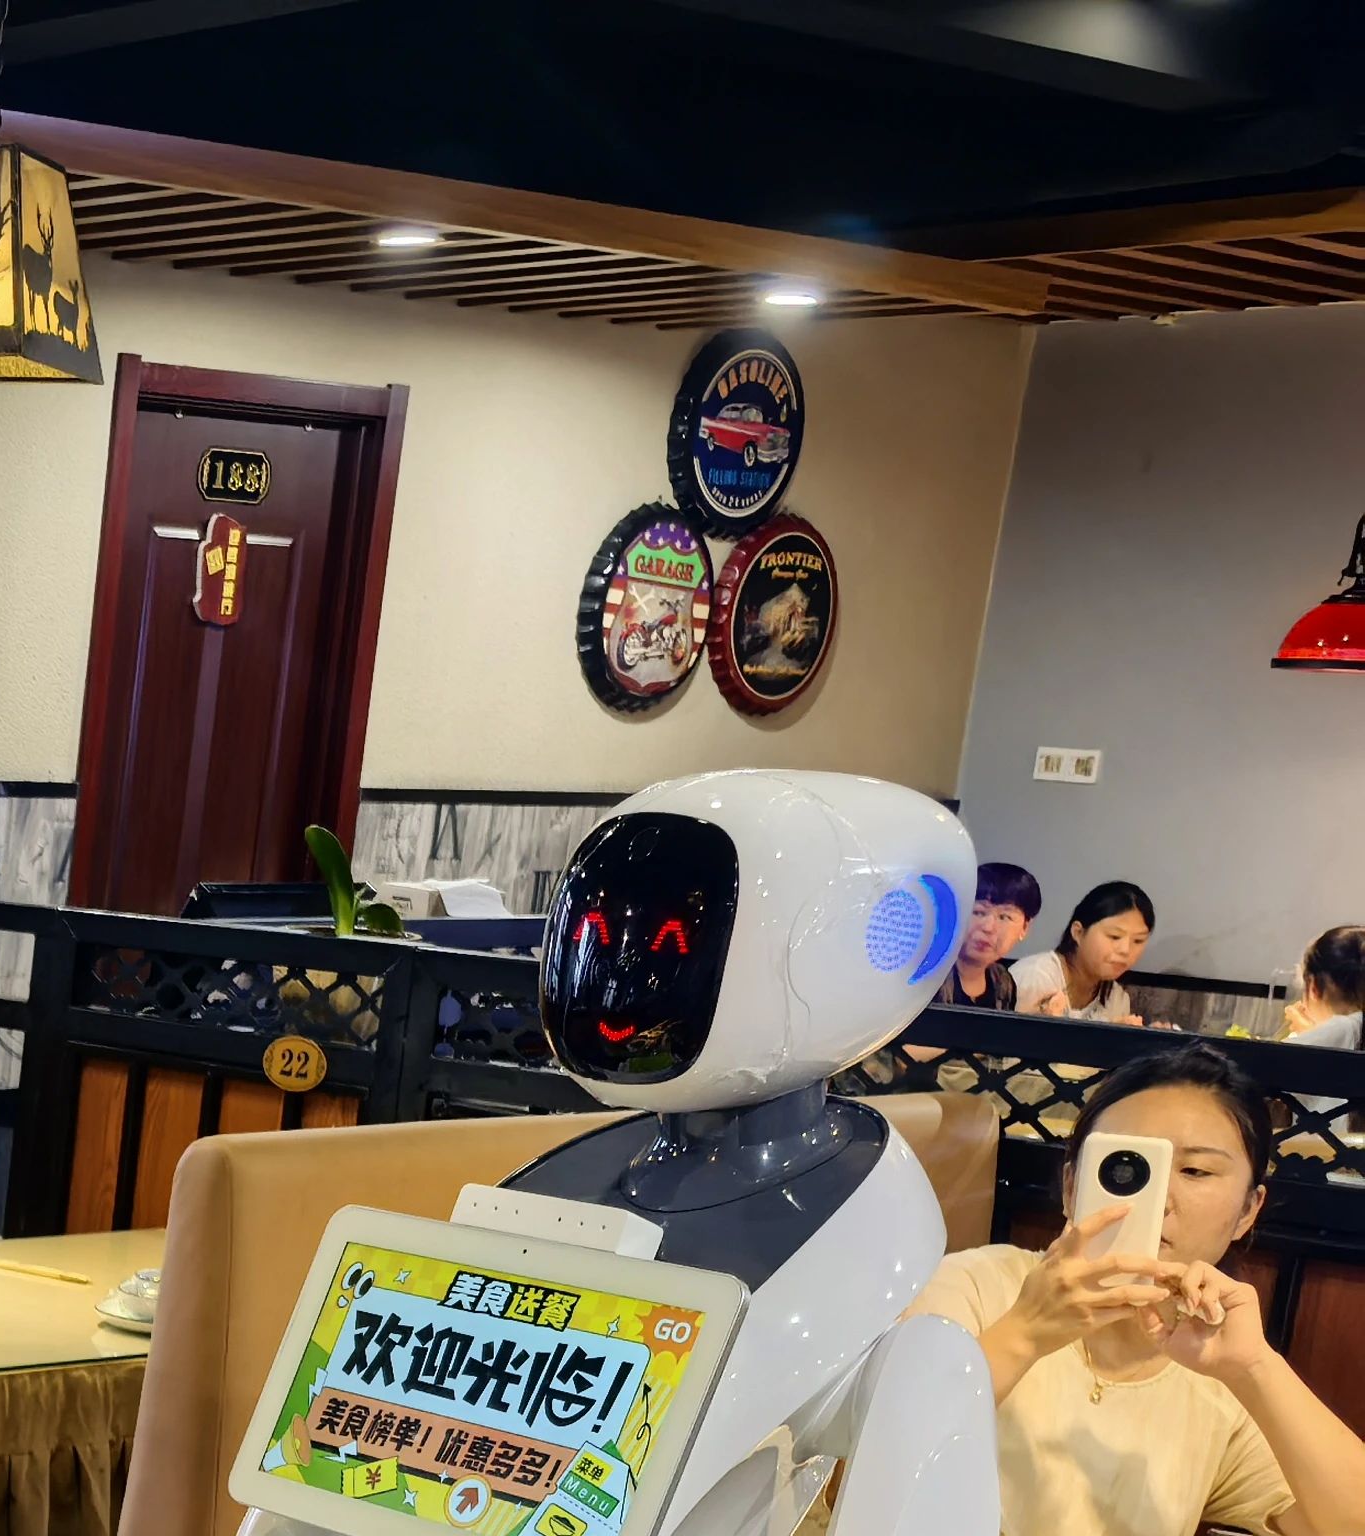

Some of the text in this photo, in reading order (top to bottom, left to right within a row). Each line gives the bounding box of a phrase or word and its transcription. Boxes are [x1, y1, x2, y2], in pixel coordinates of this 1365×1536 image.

[212, 460, 261, 493] 188
[634, 554, 696, 582] GARAGE
[759, 551, 822, 571] FRONTIER
[280, 1048, 310, 1079] 22
[440, 1271, 579, 1331] 美食送餐
[653, 1318, 693, 1346] GO
[341, 1309, 634, 1435] 欢迎光临！
[574, 1454, 606, 1483] 菜单
[563, 1477, 611, 1514] Menu
